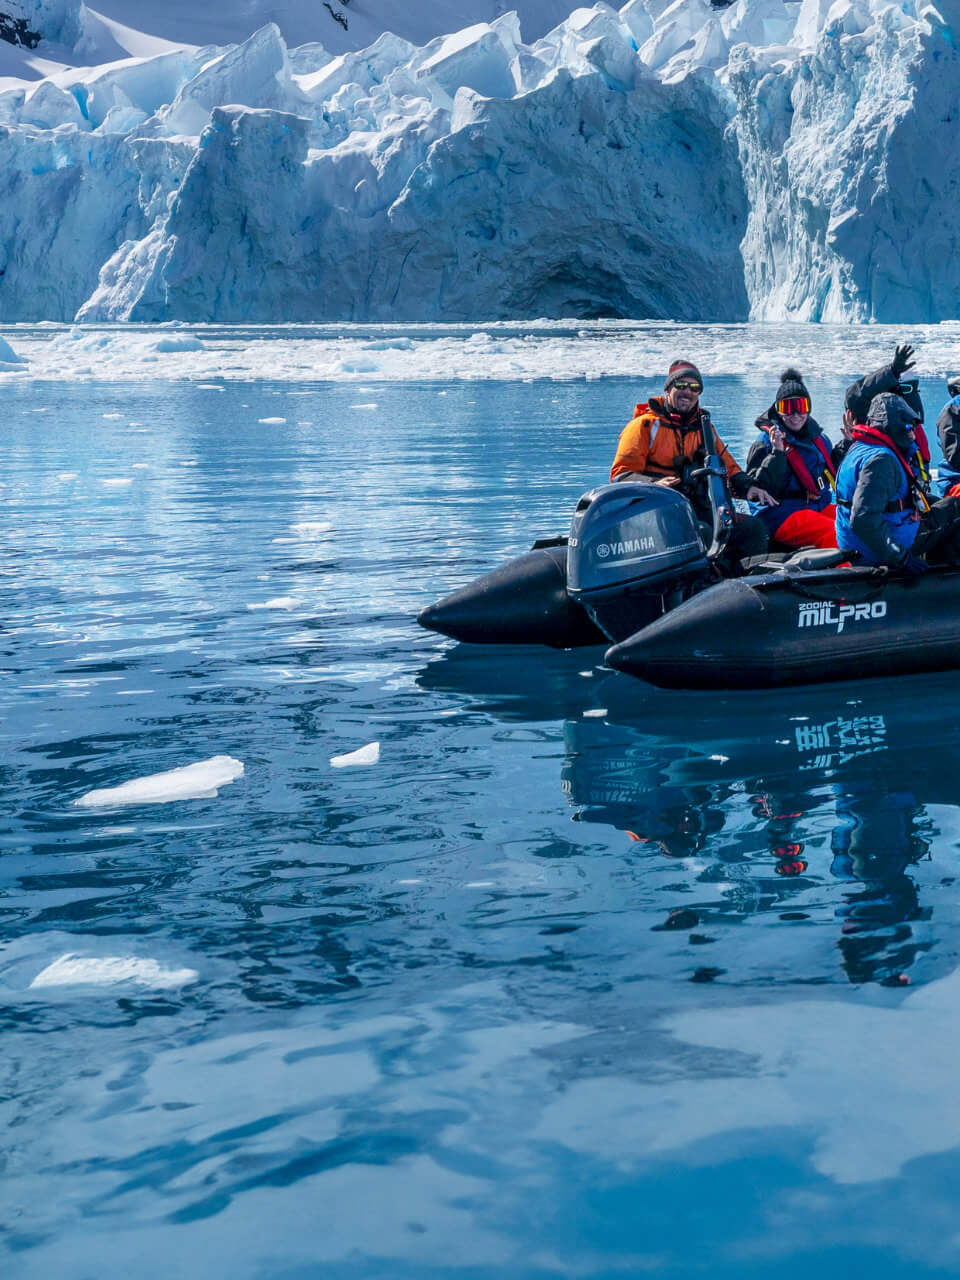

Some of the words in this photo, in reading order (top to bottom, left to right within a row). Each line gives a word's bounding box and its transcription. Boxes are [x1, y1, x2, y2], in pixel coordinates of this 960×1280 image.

[609, 536, 655, 555] YAMAHA
[798, 601, 836, 610] ZODIAC
[798, 601, 887, 633] MILPRO
